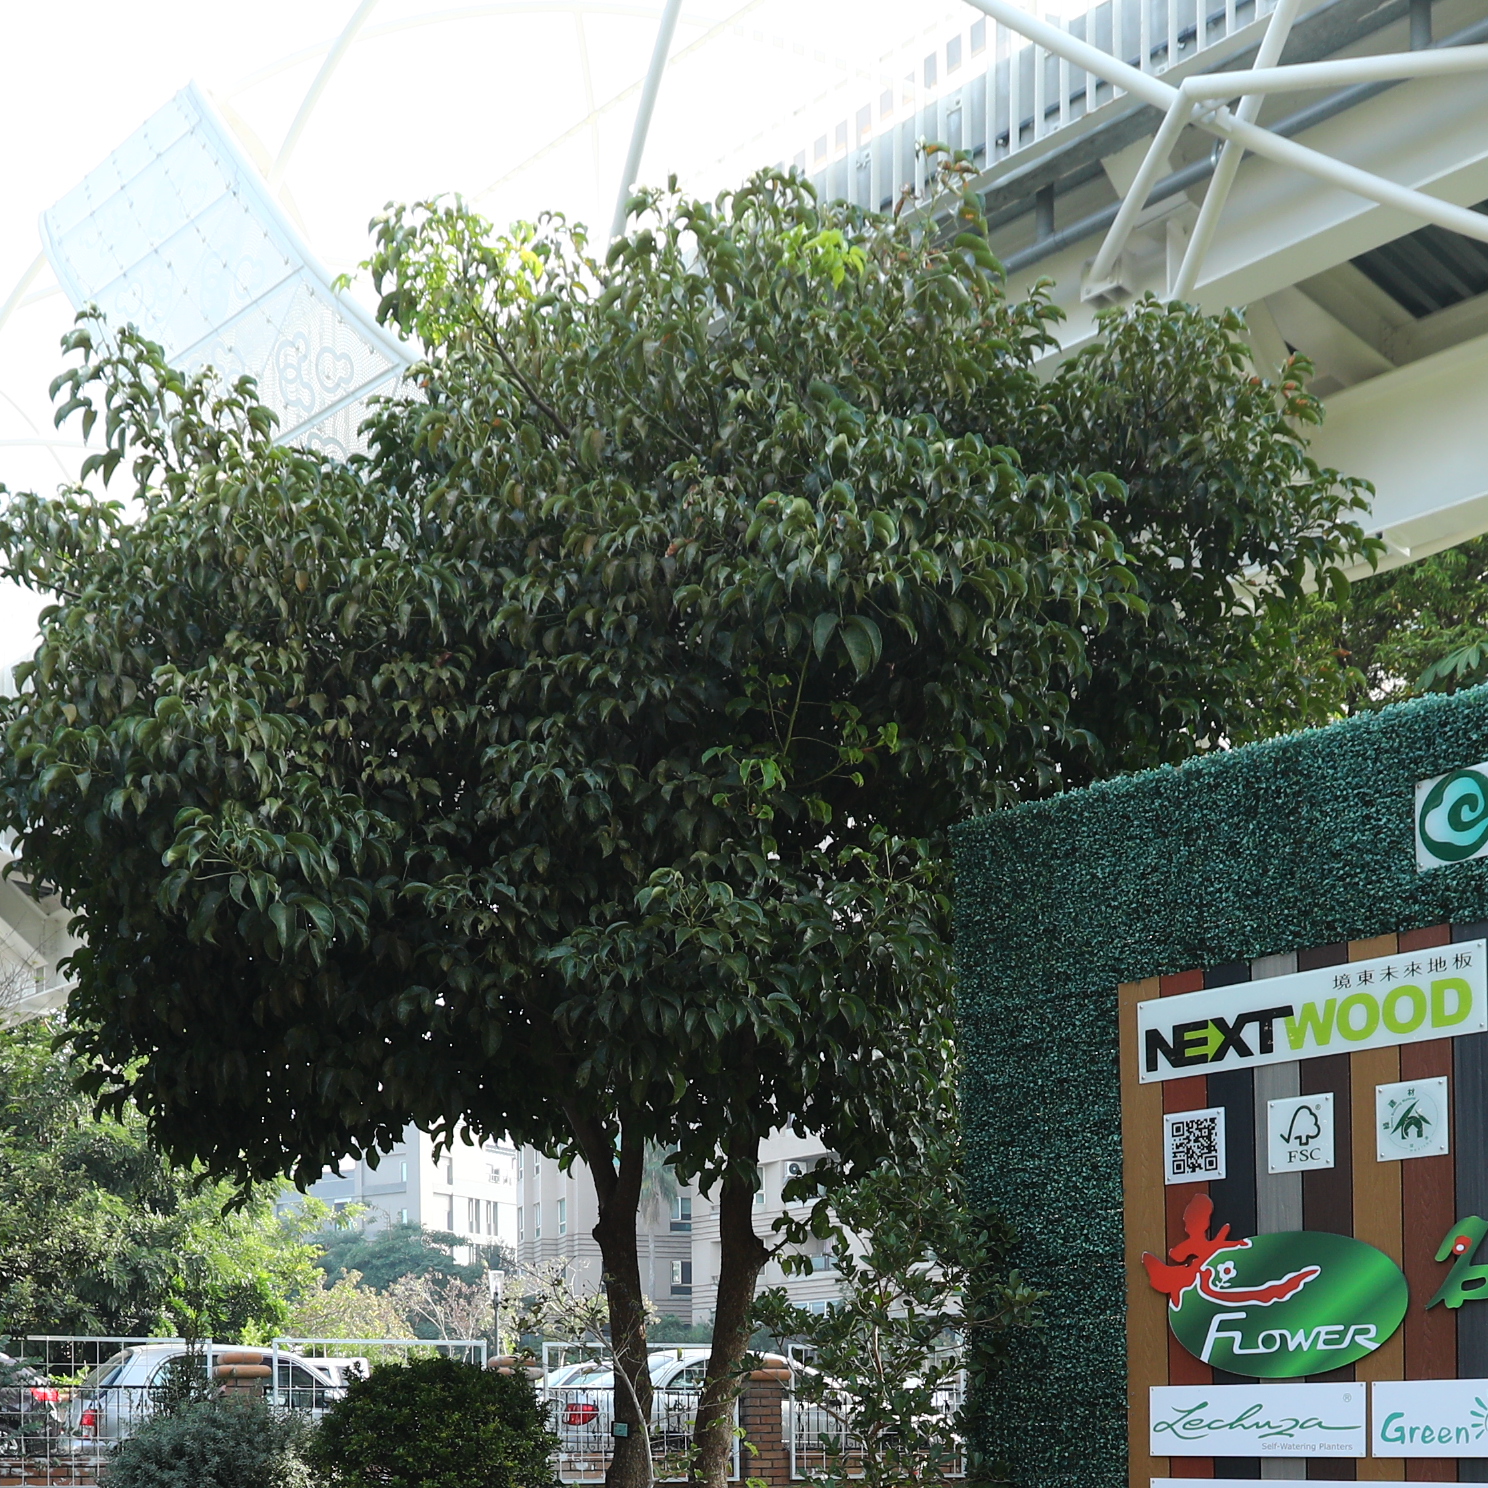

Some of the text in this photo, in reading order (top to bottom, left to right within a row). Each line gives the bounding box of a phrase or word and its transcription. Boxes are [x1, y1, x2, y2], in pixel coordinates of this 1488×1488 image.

[1332, 951, 1473, 991] 境東未來地板
[1287, 1147, 1322, 1164] FSC
[1153, 1401, 1362, 1440] Lechuza
[1380, 1411, 1470, 1445] Green
[1261, 1441, 1354, 1452] Self-Watering Planters
